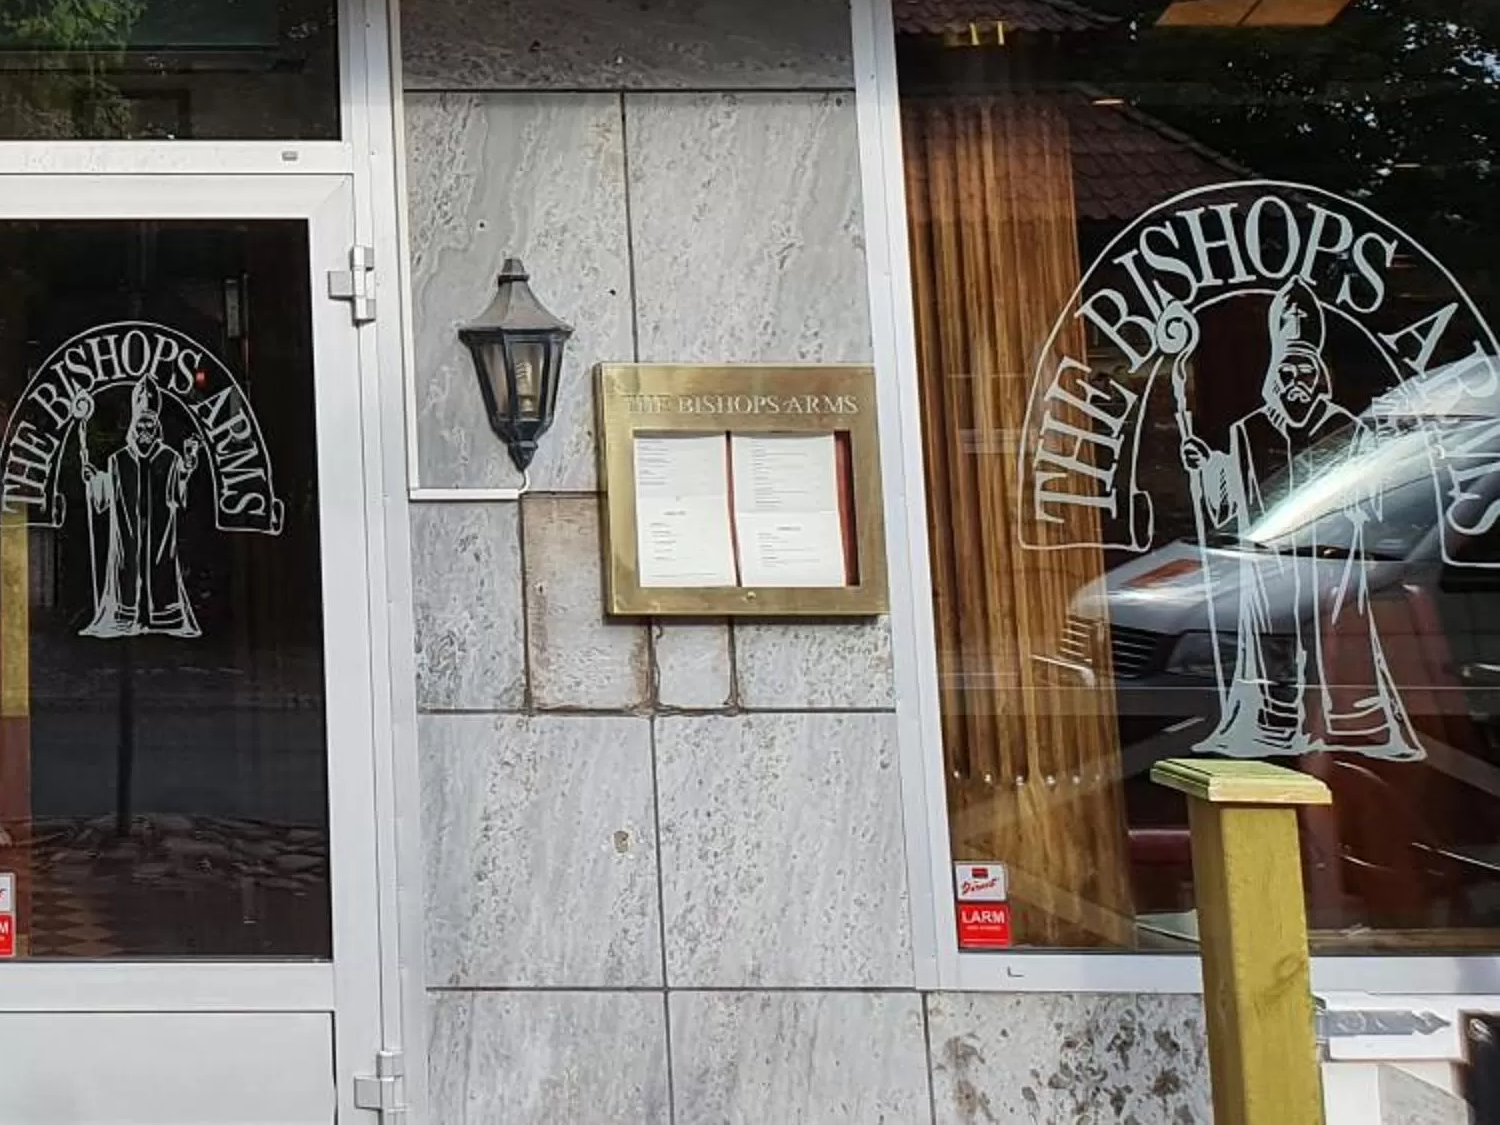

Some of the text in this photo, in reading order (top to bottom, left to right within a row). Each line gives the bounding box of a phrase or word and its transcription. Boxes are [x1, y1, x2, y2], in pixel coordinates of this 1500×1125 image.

[1074, 195, 1397, 373] BISHOPS
[3, 330, 267, 516] THE BISHOPS ARMS
[678, 394, 780, 414] BISHOPS
[781, 394, 859, 414] ARMS
[1033, 356, 1138, 524] THE
[962, 910, 1004, 924] LARM
